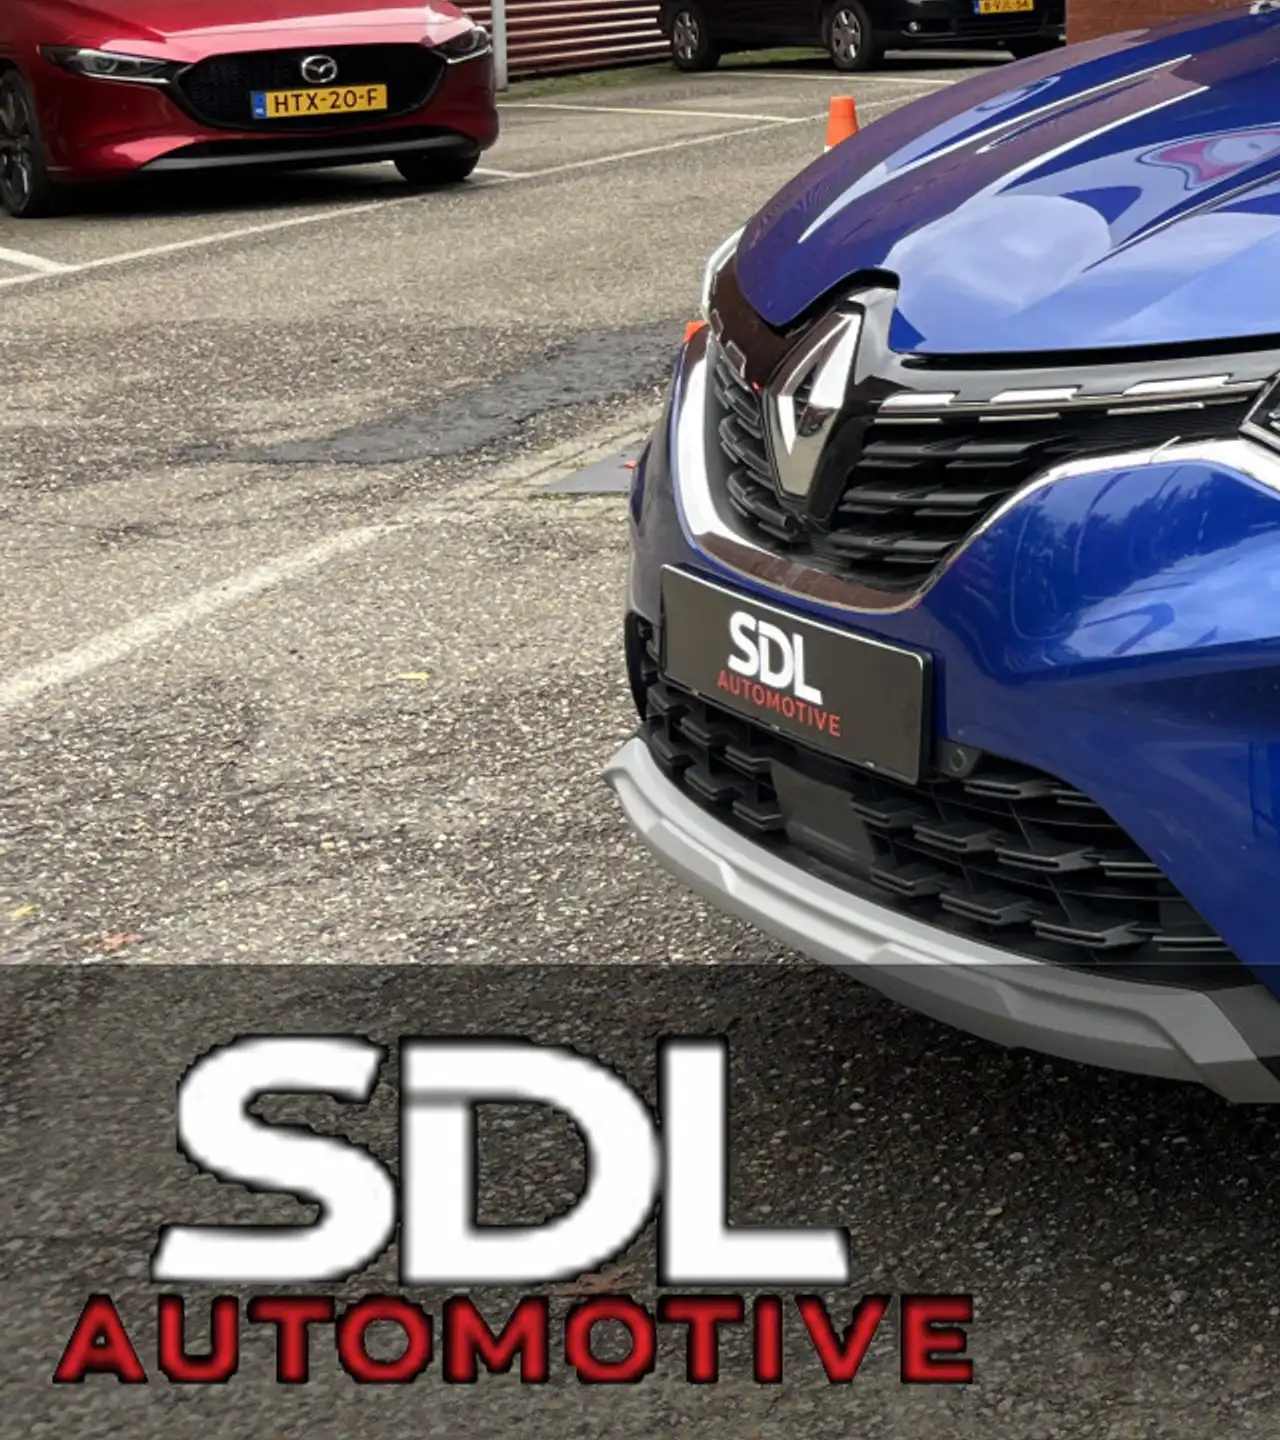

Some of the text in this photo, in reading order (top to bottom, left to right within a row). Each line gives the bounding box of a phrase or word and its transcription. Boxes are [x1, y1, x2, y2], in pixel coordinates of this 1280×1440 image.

[274, 88, 377, 113] HTX-20-F
[727, 611, 823, 705] SDL
[717, 670, 841, 737] AUTOMOTIVE
